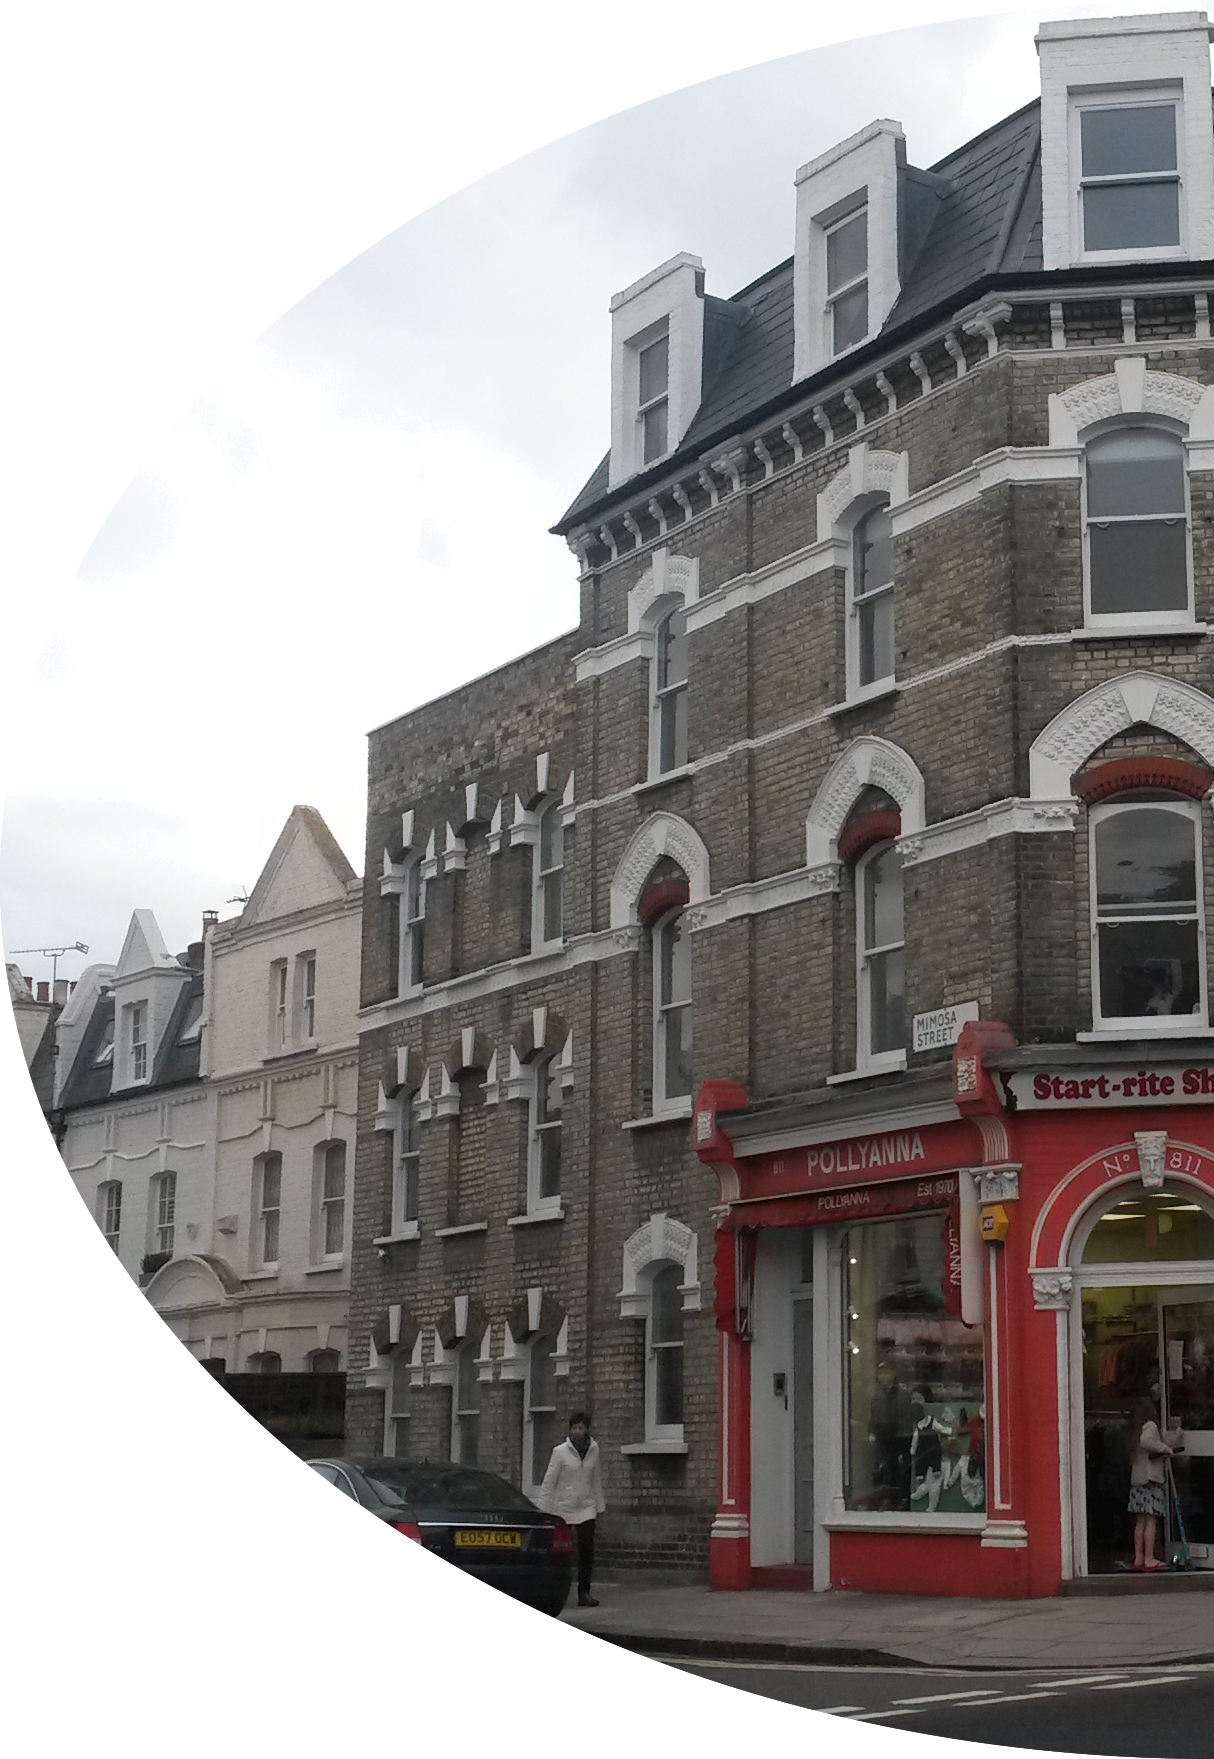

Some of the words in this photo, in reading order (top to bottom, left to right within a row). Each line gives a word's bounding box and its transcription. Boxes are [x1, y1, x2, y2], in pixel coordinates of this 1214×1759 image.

[916, 1010, 957, 1032] MIMOSA
[917, 1026, 954, 1047] STREET
[1033, 1070, 1175, 1100] Start-rite
[806, 1132, 925, 1177] POLLYANNA
[1169, 1151, 1202, 1175] 811
[817, 1191, 870, 1210] POLLYANNA
[917, 1182, 933, 1197] Est
[935, 1179, 955, 1195] 1970
